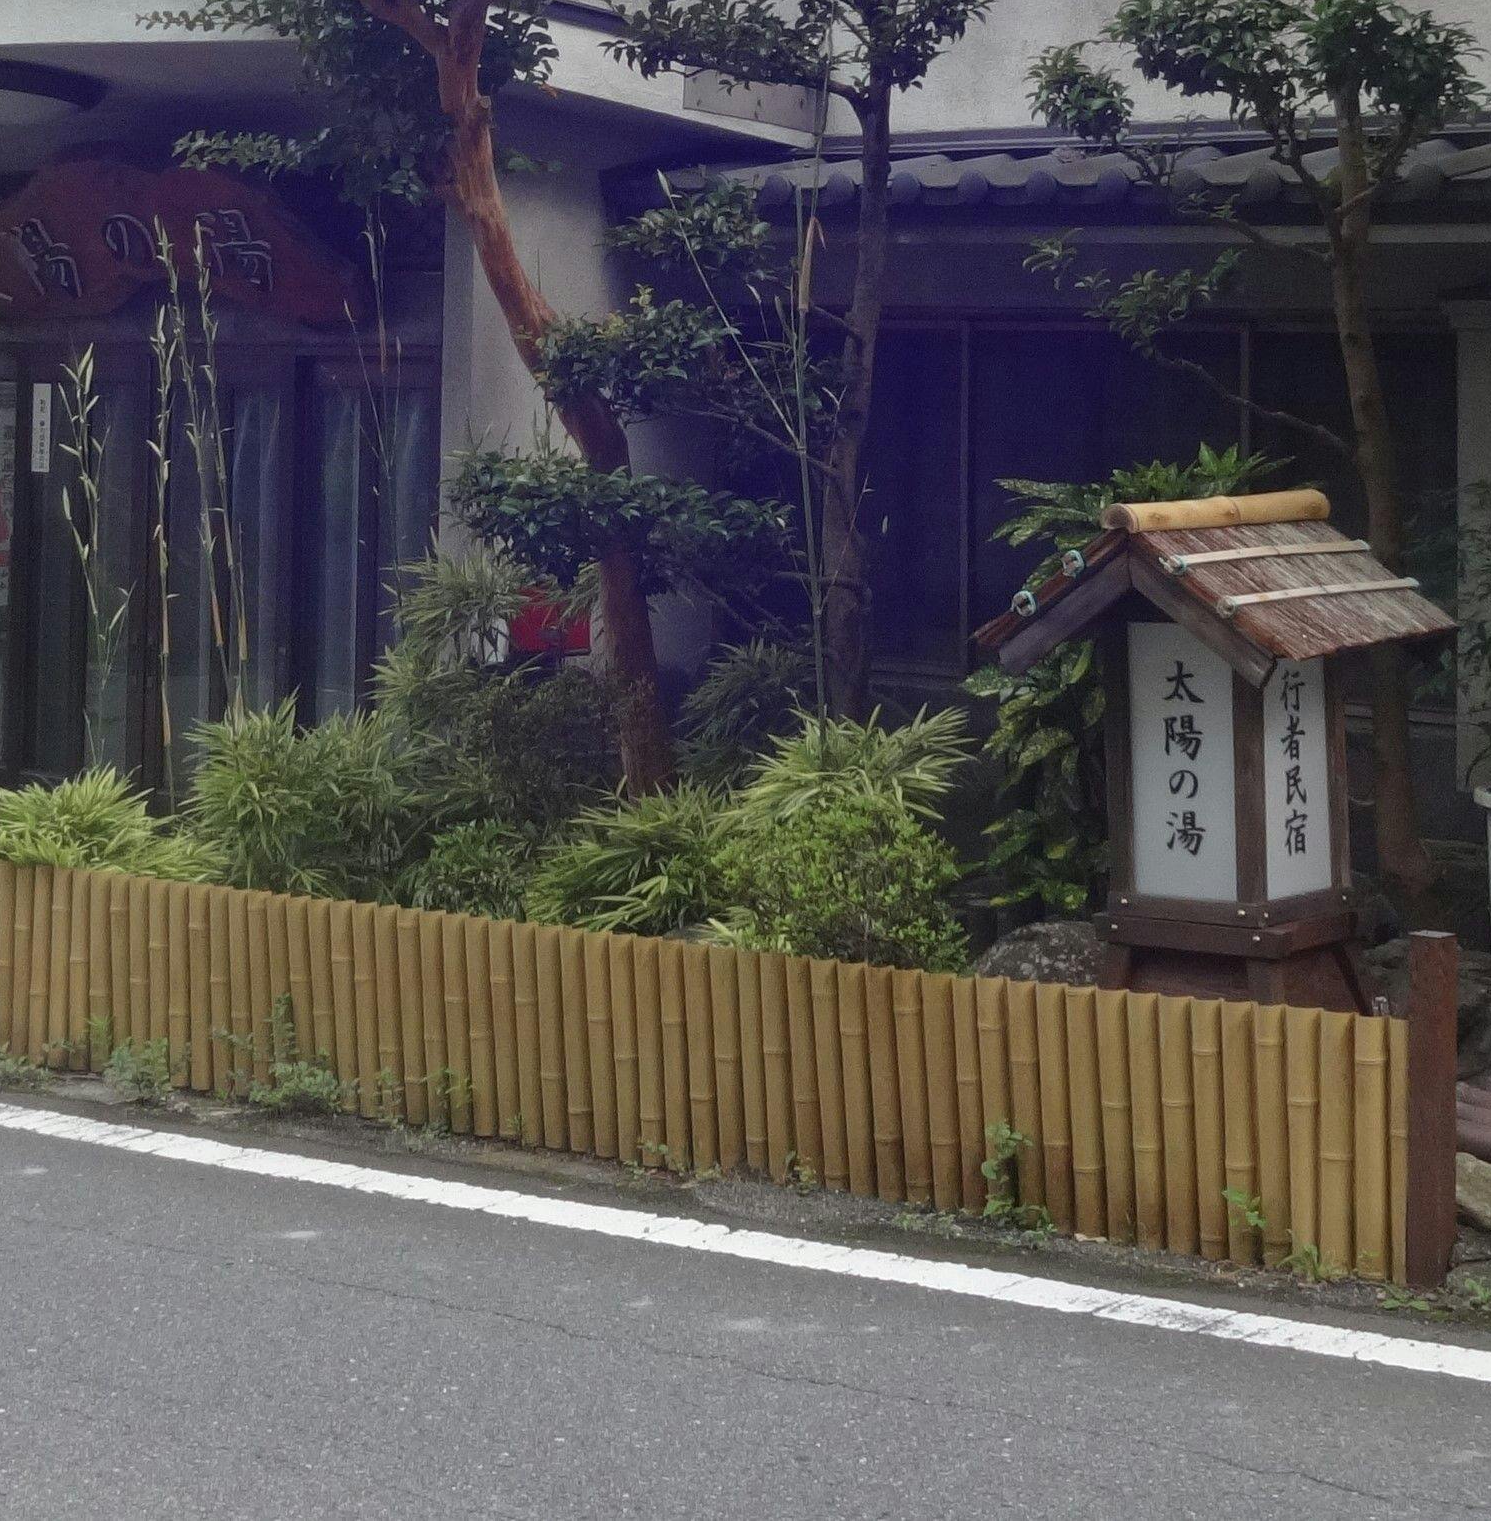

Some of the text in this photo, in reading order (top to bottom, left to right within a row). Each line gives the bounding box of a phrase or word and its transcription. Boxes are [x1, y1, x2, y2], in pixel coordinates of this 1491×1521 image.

[1162, 660, 1207, 857] 太陽の湯
[1280, 669, 1308, 857] 行者民宿
